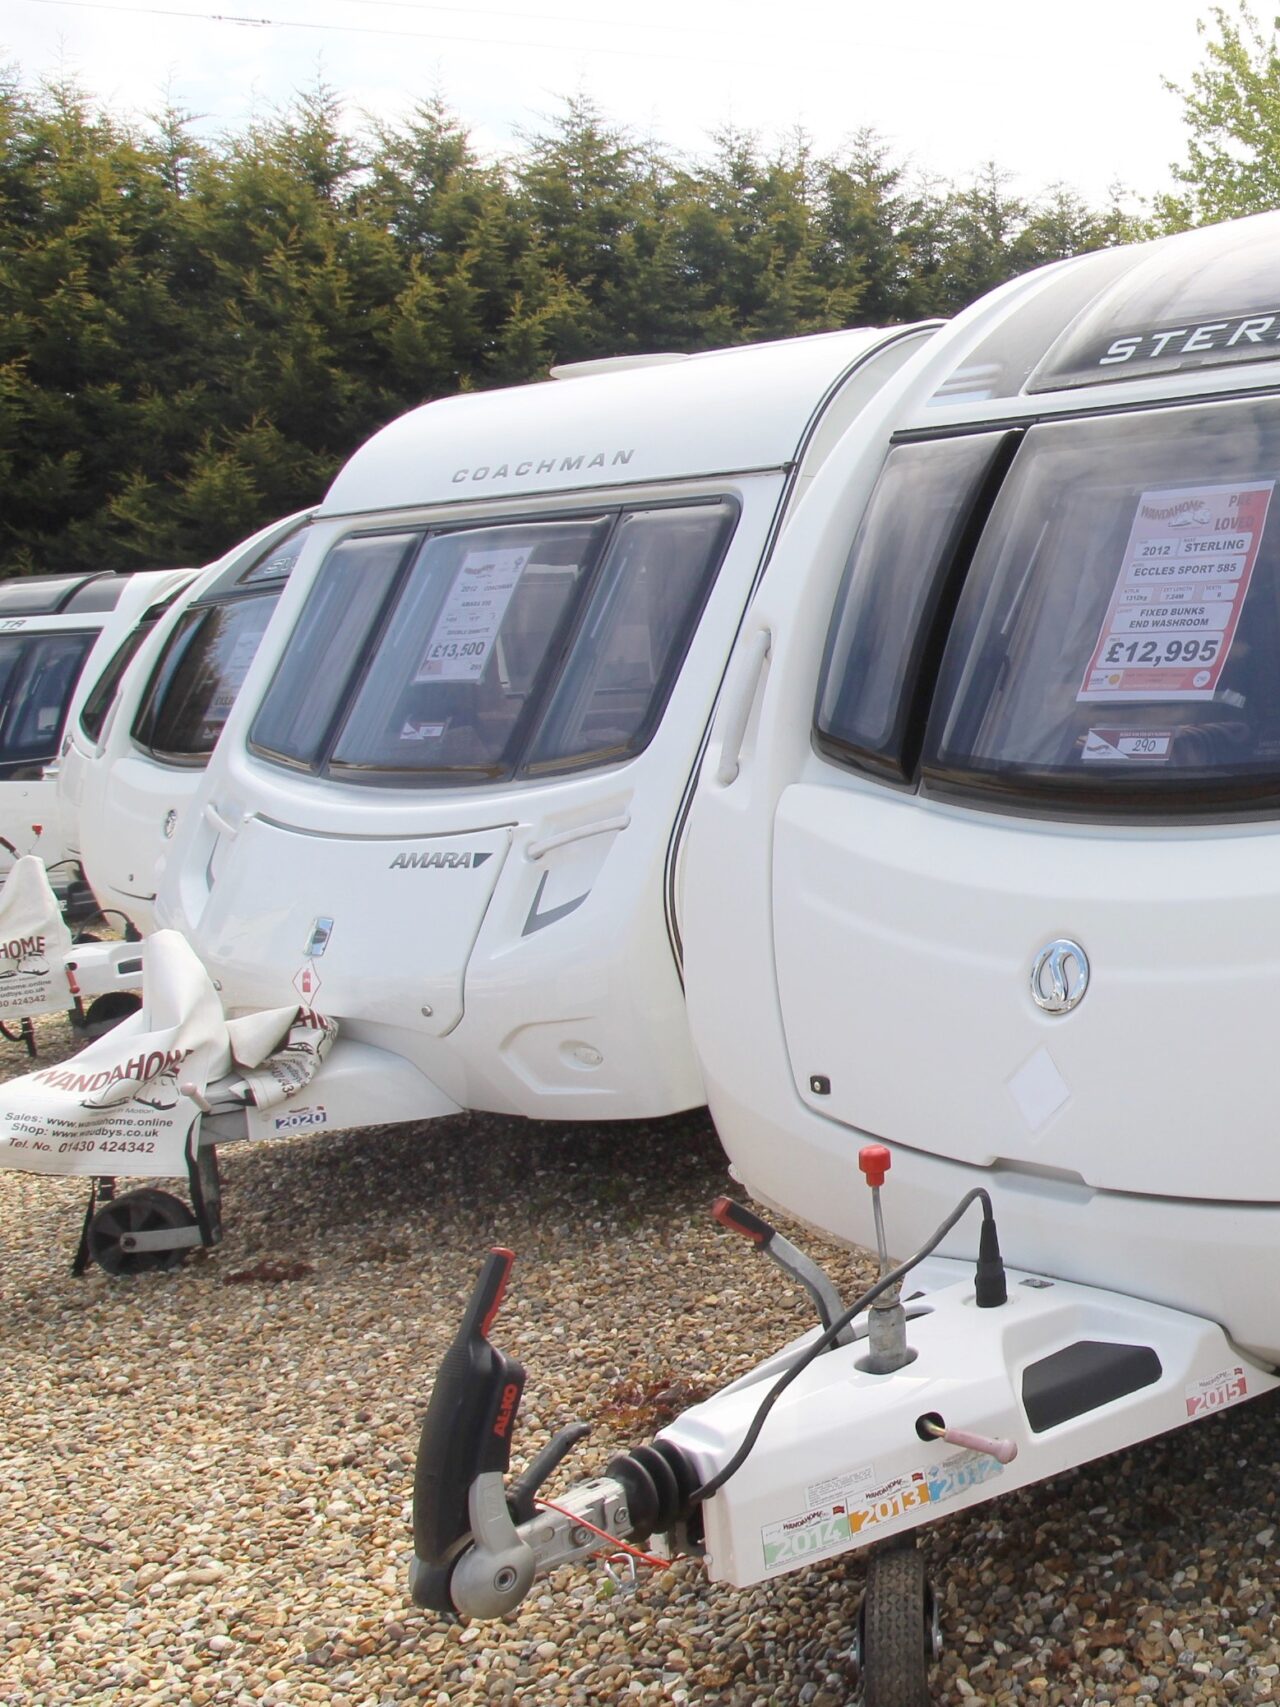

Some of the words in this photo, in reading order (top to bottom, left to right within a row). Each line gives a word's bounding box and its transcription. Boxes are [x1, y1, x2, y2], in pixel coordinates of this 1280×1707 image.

[451, 449, 635, 483] COACHMAN
[1214, 517, 1255, 532] LOVED
[1142, 546, 1171, 556] 2012
[1184, 539, 1245, 554] STERLING
[1133, 566, 1175, 577] ECCLES
[1177, 564, 1214, 575] SPORT
[1216, 562, 1237, 573] 585
[1140, 608, 1168, 616] FIXED
[1170, 607, 1205, 616] BUNKS
[1129, 620, 1149, 628] END
[1151, 618, 1209, 628] WASHROOM
[431, 641, 486, 659] £13,500
[1105, 639, 1219, 667] £12,995
[1132, 739, 1156, 752] 290
[388, 852, 471, 869] AMARA
[5, 1112, 43, 1125] Sales:
[277, 1112, 326, 1130] 2020
[11, 1123, 48, 1136] Shop:
[8, 1138, 29, 1149] Tel.
[32, 1141, 52, 1152] No.
[58, 1141, 95, 1153] 01430
[99, 1141, 155, 1154] 424342
[1192, 1382, 1241, 1416] 2015
[860, 1487, 923, 1533] 2013
[774, 1520, 844, 1562] 2014
